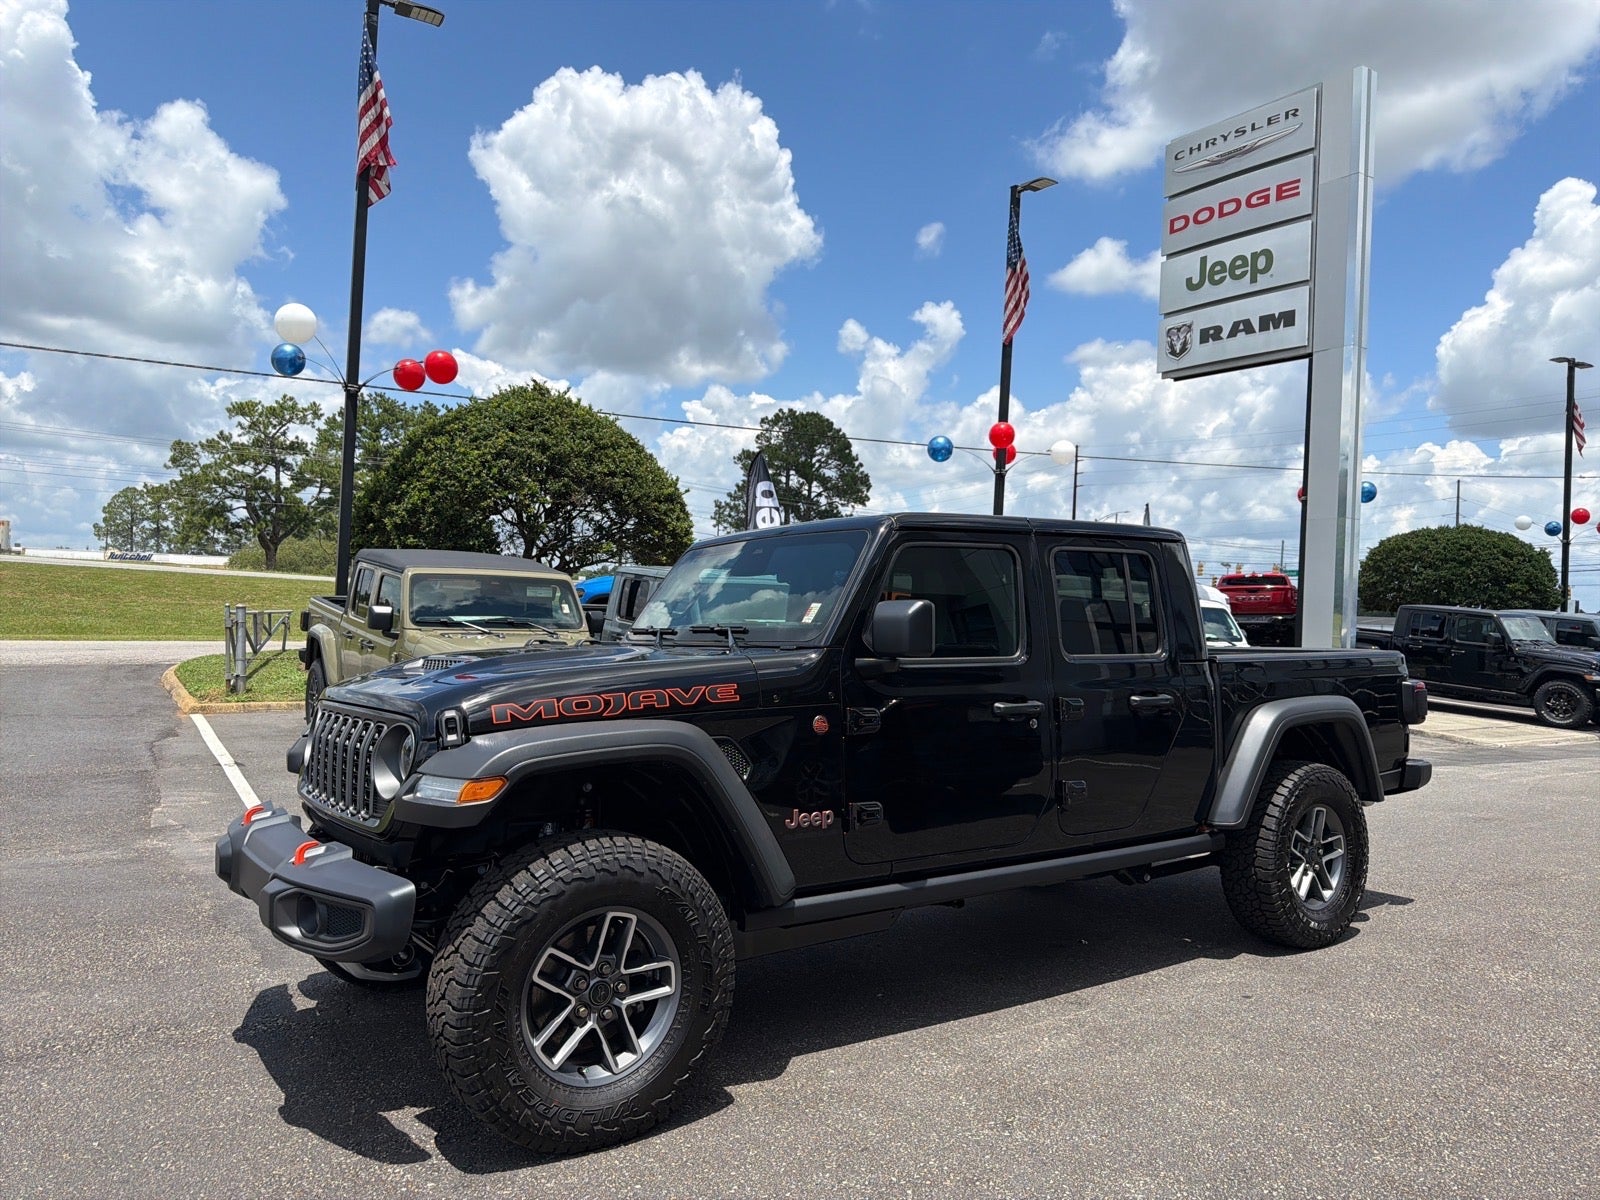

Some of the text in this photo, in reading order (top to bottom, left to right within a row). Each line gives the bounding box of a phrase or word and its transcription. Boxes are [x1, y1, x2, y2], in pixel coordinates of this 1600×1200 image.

[1174, 107, 1300, 161] CHRYSLER
[1169, 178, 1301, 235] DODGE
[1185, 247, 1274, 292] Jeep
[1199, 309, 1296, 345] RAM
[755, 480, 781, 529] ep
[491, 683, 740, 724] MOJAVE
[785, 808, 835, 830] Jeep
